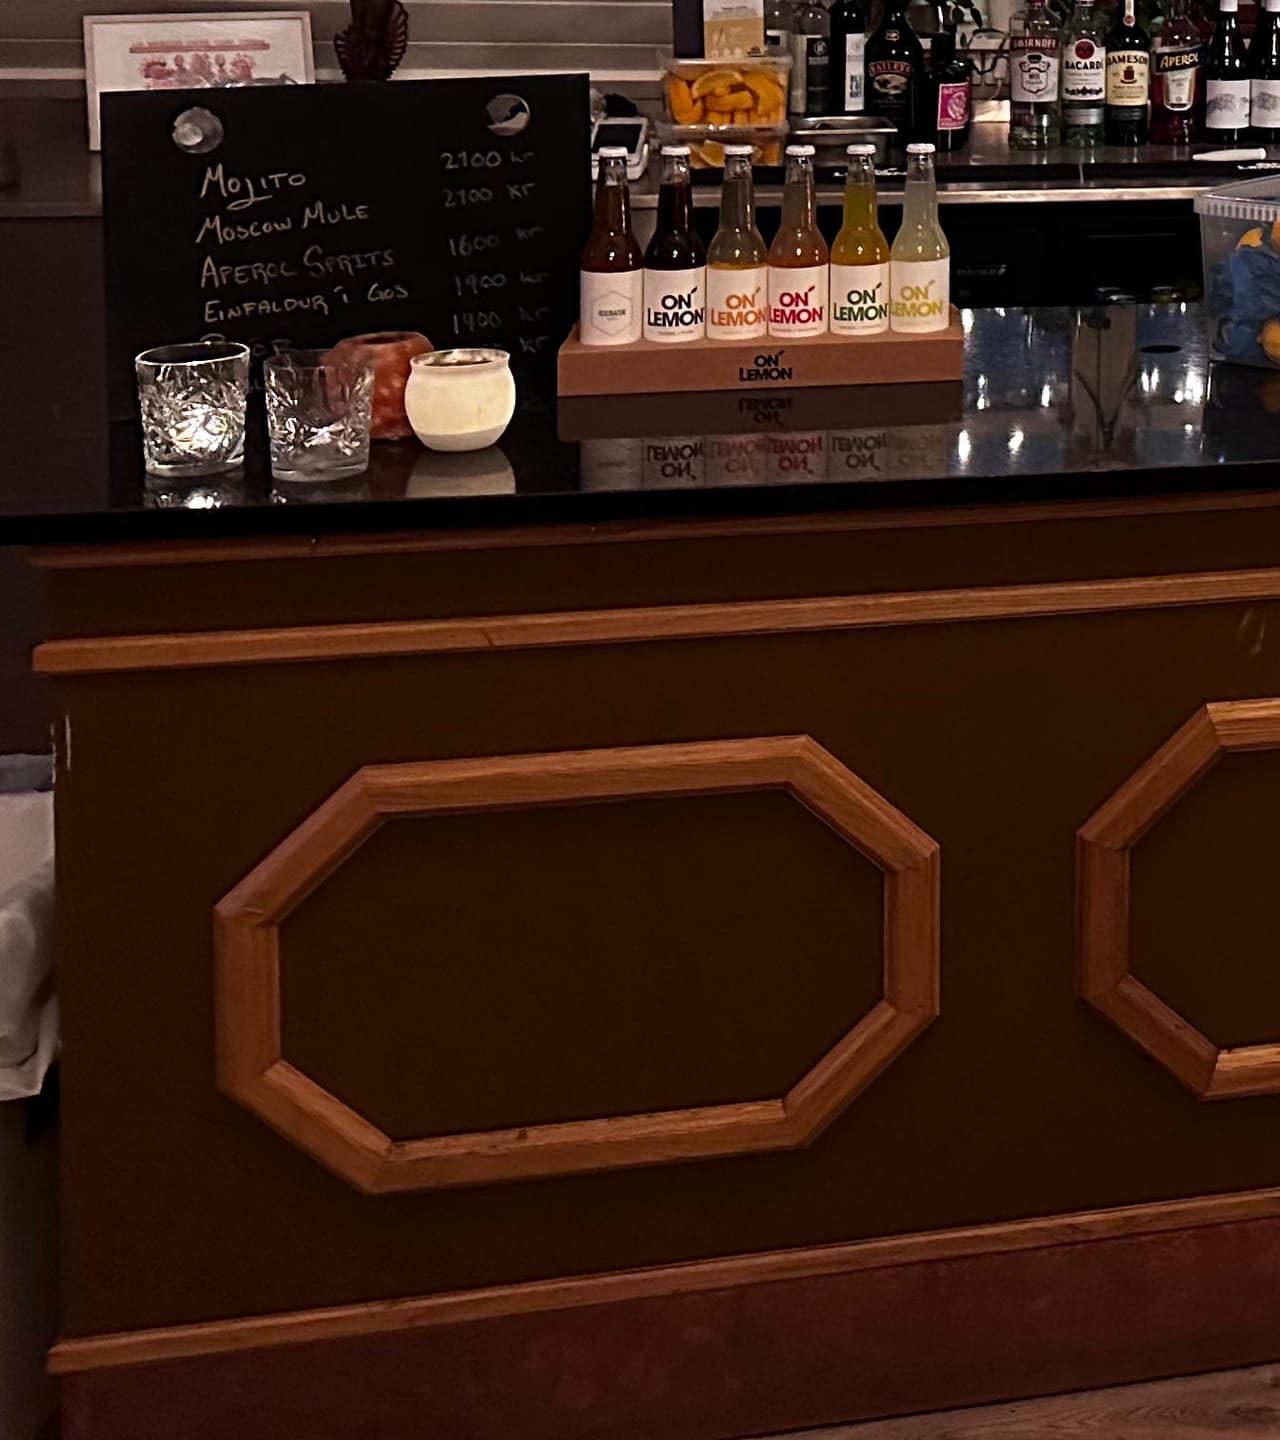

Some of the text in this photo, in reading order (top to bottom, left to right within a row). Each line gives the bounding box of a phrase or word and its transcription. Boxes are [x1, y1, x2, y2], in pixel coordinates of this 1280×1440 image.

[1012, 37, 1057, 50] SMIRNOFF
[1159, 51, 1200, 69] APEROL
[779, 292, 809, 307] ON
[847, 289, 876, 305] ON
[900, 285, 929, 301] ON
[661, 294, 692, 310] ON
[726, 294, 755, 310] ON
[647, 307, 705, 327] LEMON
[710, 307, 767, 327] LEMON
[769, 304, 824, 324] LEMON
[833, 302, 889, 322] LEMON
[754, 354, 779, 367] ON
[739, 365, 793, 382] LEMON
